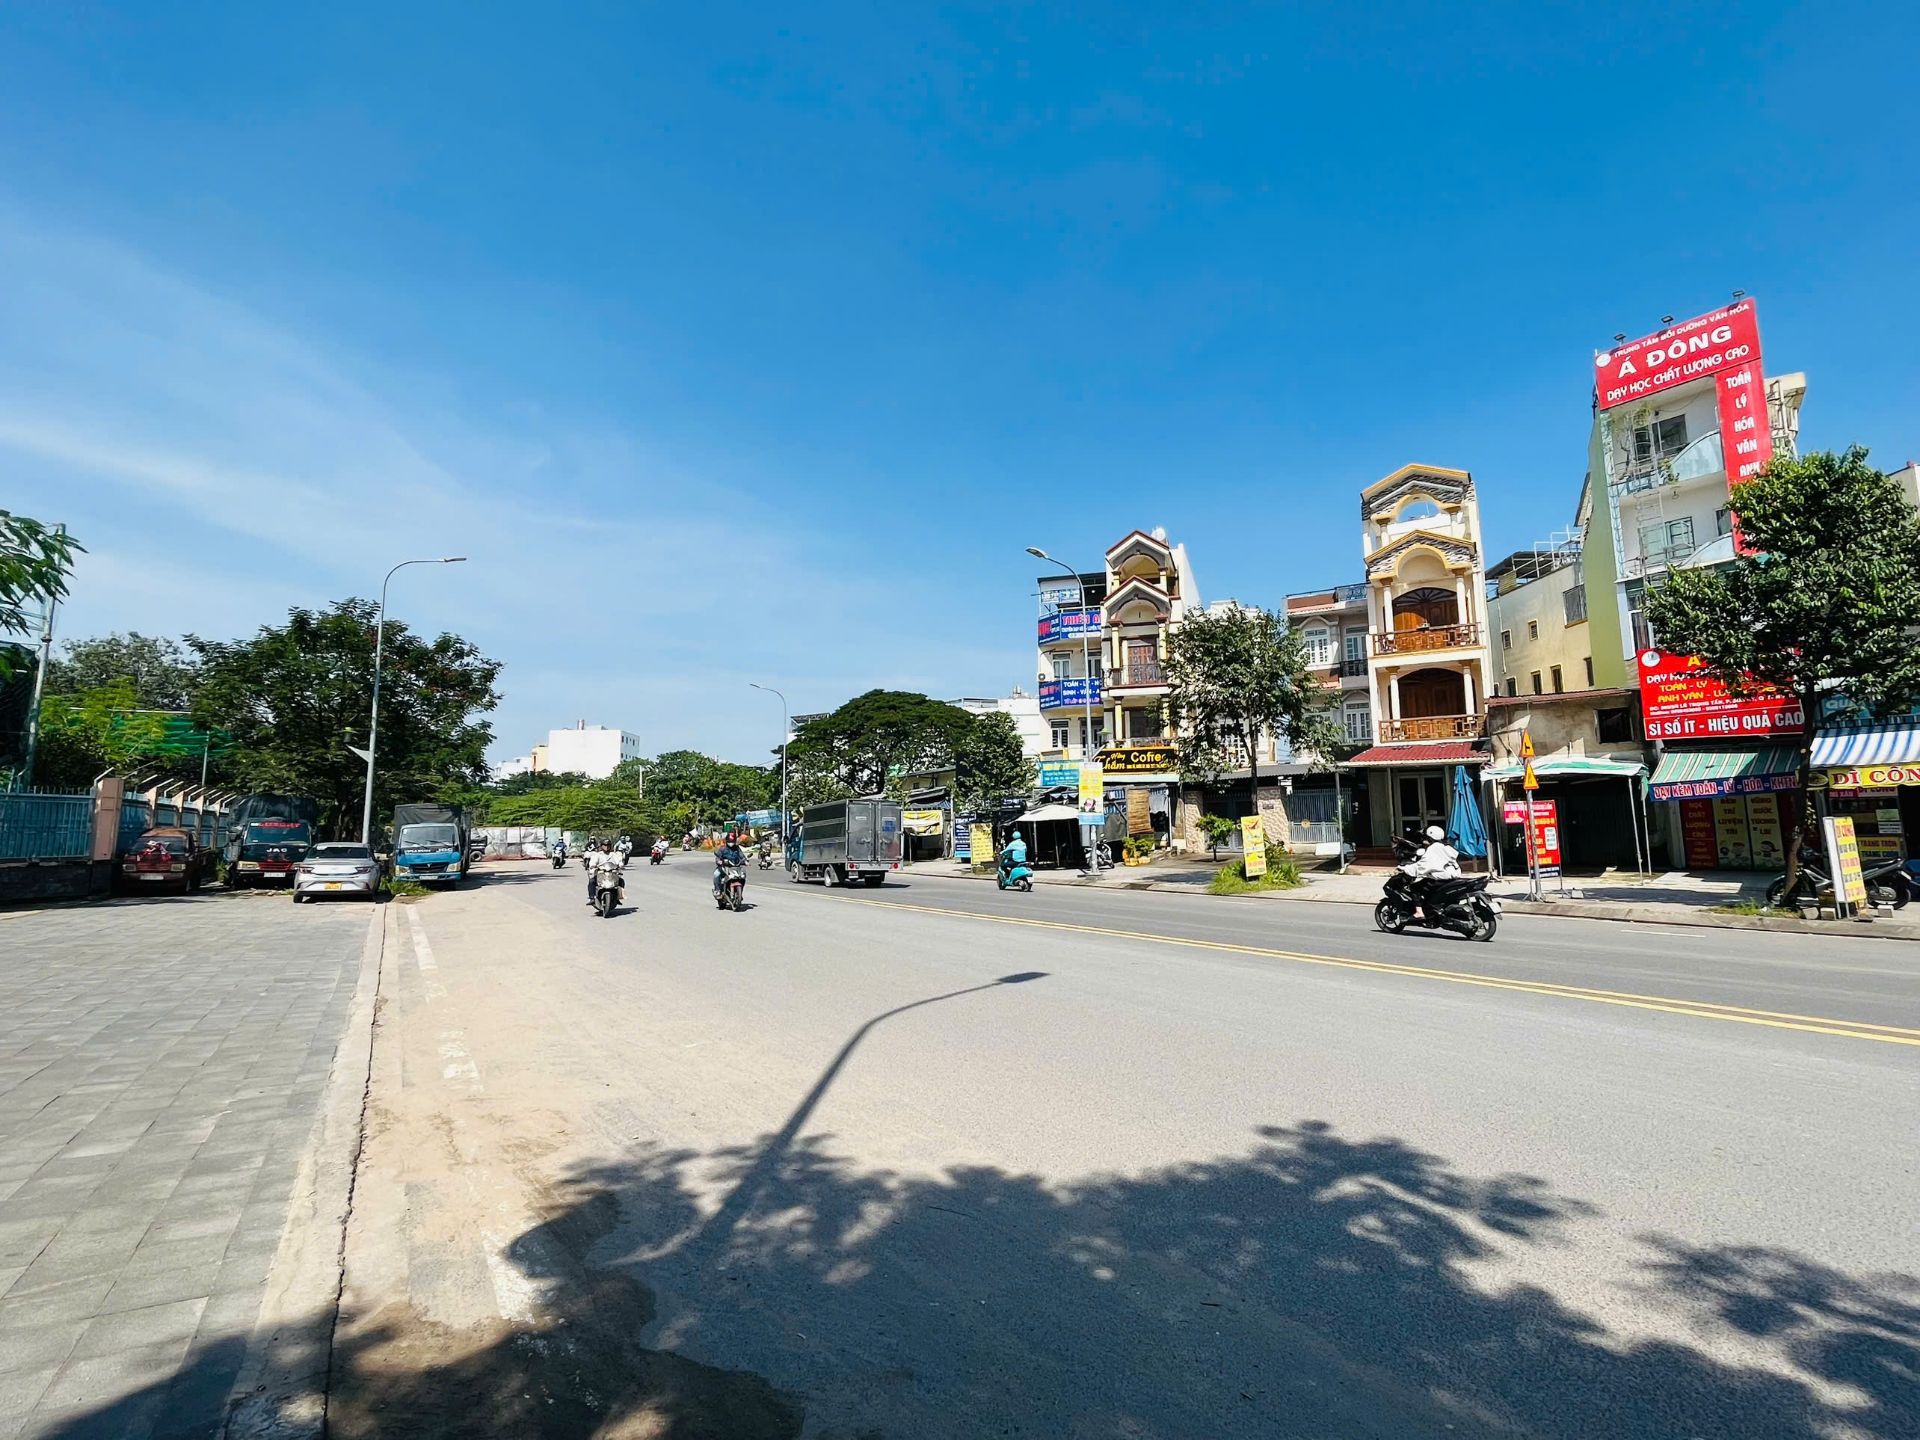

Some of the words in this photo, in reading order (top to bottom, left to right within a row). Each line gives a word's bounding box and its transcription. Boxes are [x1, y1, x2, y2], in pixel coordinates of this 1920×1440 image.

[1618, 356, 1637, 379] Á
[1646, 325, 1732, 367] ĐÔNG
[1607, 386, 1627, 401] DẠY
[1630, 378, 1651, 395] HỌC
[1653, 366, 1680, 385] CHẤT
[1683, 353, 1722, 375] LƯỢNG
[1725, 344, 1749, 361] CAO
[1726, 371, 1752, 389] TOÁN
[1735, 393, 1748, 409] LÝ
[1734, 416, 1755, 433] HÓA
[1736, 439, 1758, 455] VĂN
[1664, 716, 1682, 734] SỐ
[1684, 718, 1696, 733] ÍT
[1707, 715, 1739, 734] HIỆU
[1742, 709, 1771, 728] QUẢ
[1775, 711, 1804, 726] CAO
[1653, 785, 1672, 800] DẠY
[1672, 782, 1693, 797] KÈM
[1693, 779, 1718, 796] TOÁN
[1724, 777, 1736, 793] LÝ
[1743, 776, 1764, 792] HÓA
